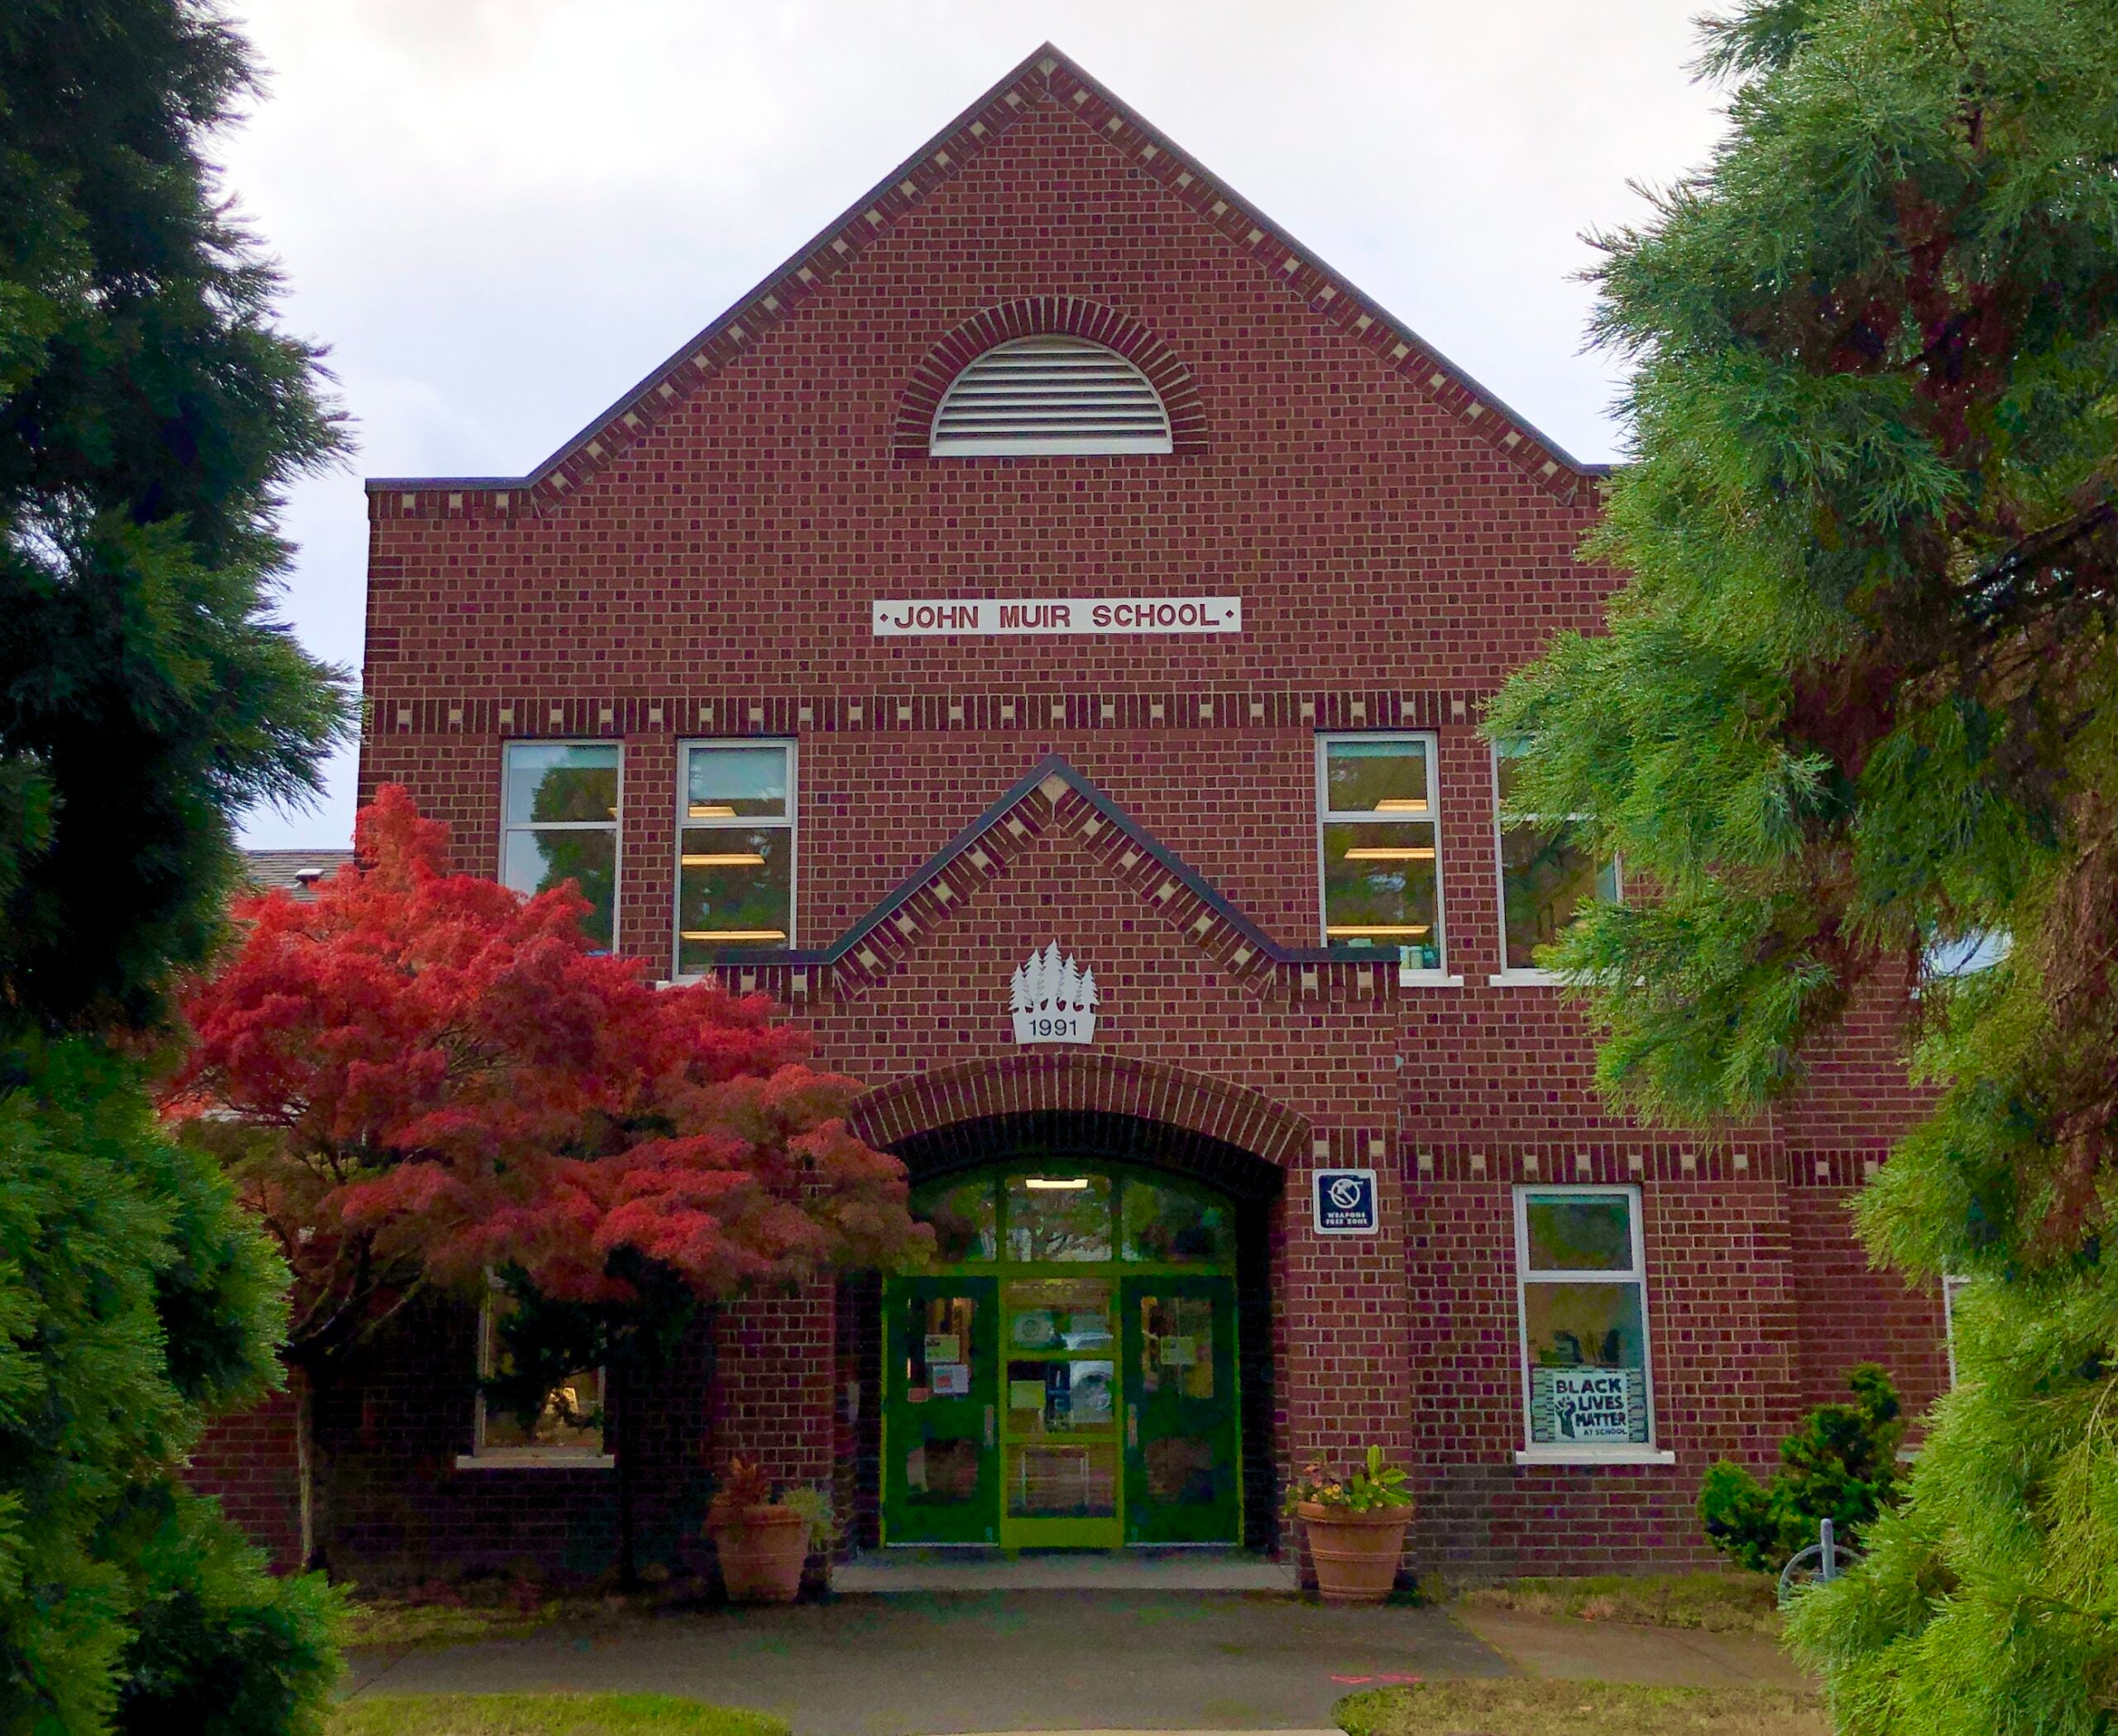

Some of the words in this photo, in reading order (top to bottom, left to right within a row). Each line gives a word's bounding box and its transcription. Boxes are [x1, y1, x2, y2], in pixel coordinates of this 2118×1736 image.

[894, 606, 979, 629] JOHN
[999, 605, 1071, 628] MUIR
[1092, 603, 1220, 627] SCHOOL
[1029, 1019, 1076, 1036] 1991
[1555, 1378, 1622, 1393] BLACK
[1578, 1395, 1624, 1411] LIVES
[1575, 1412, 1627, 1427] MATTER
